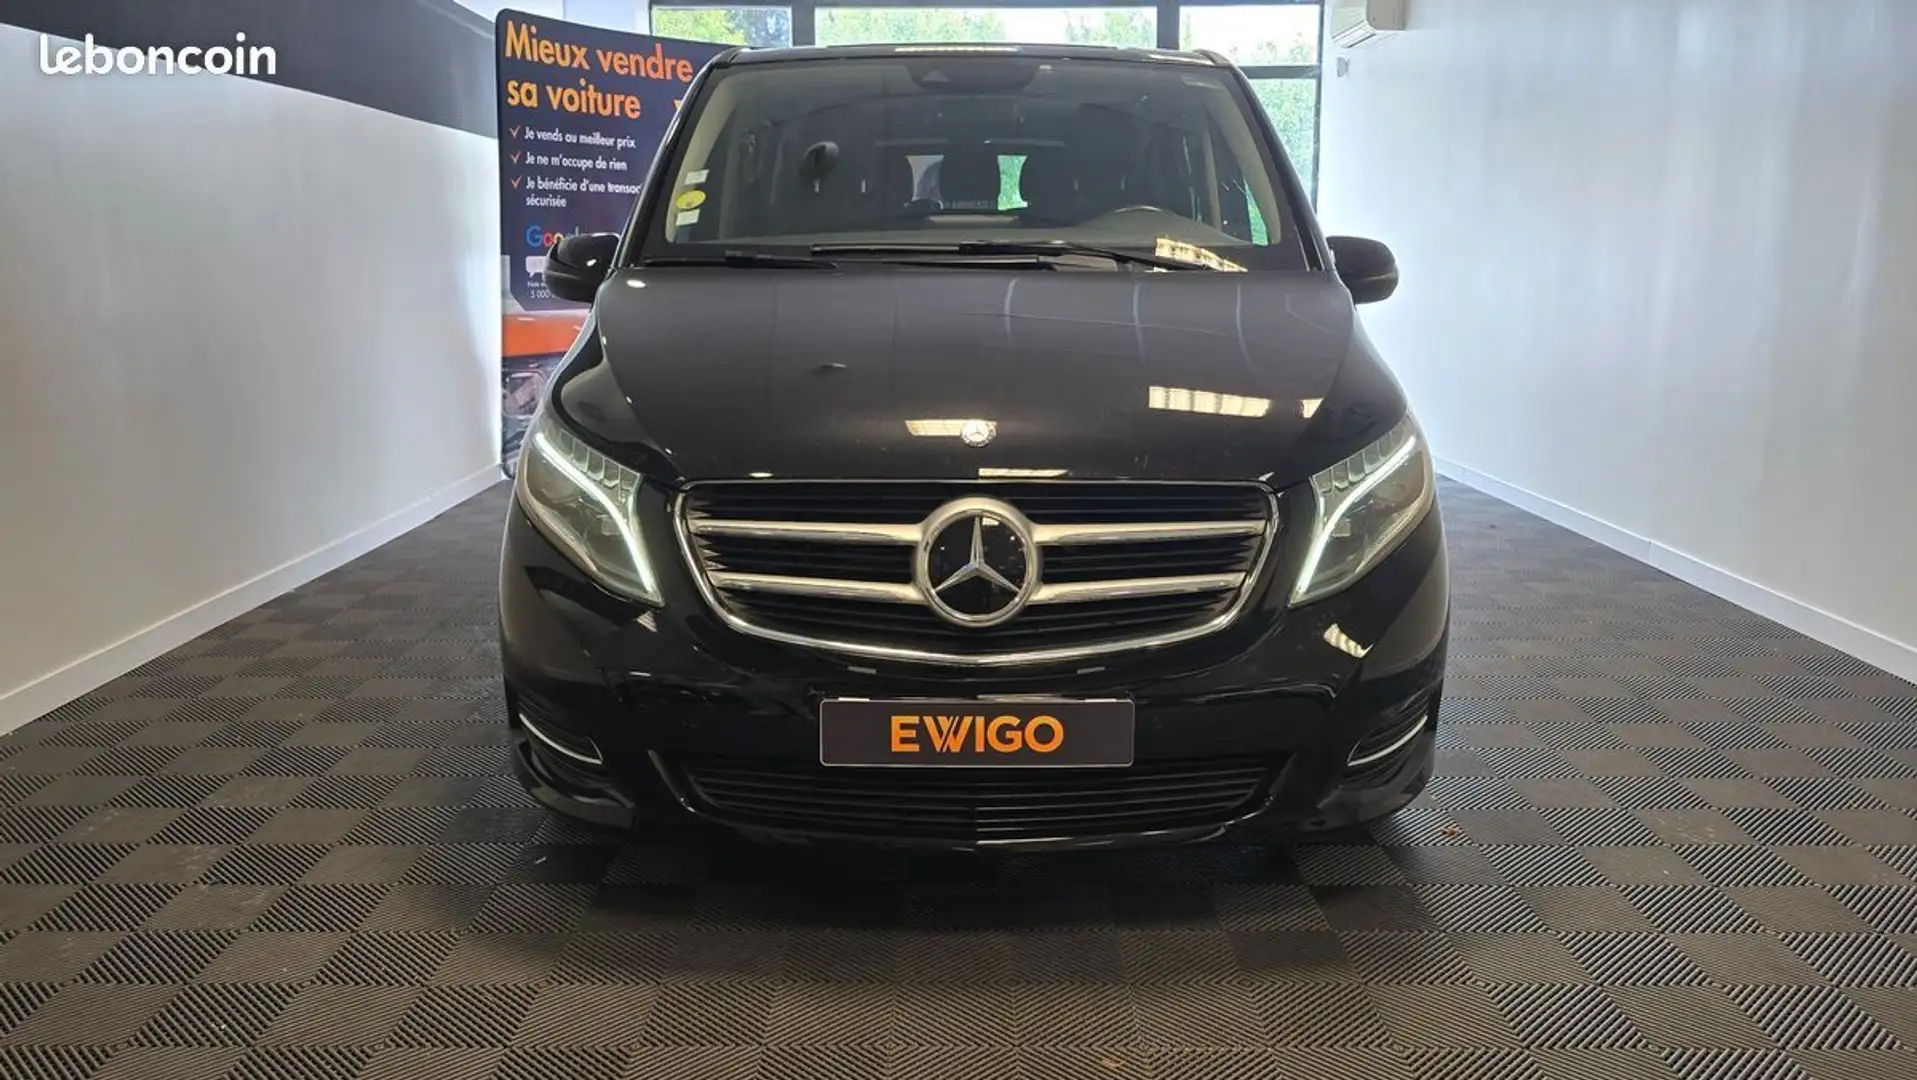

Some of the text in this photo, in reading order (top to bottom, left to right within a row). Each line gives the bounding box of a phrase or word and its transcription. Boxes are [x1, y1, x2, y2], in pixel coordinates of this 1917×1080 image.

[505, 20, 693, 83] Mieux vendre
[507, 78, 641, 119] sa voiture
[524, 126, 636, 150] Je vends au meilleur prix
[525, 152, 627, 171] Je ne m'occupe de rien
[525, 176, 641, 195] Je bénéficie d'une transac
[526, 194, 567, 208] sécurisée
[891, 715, 1064, 753] EWIGO
